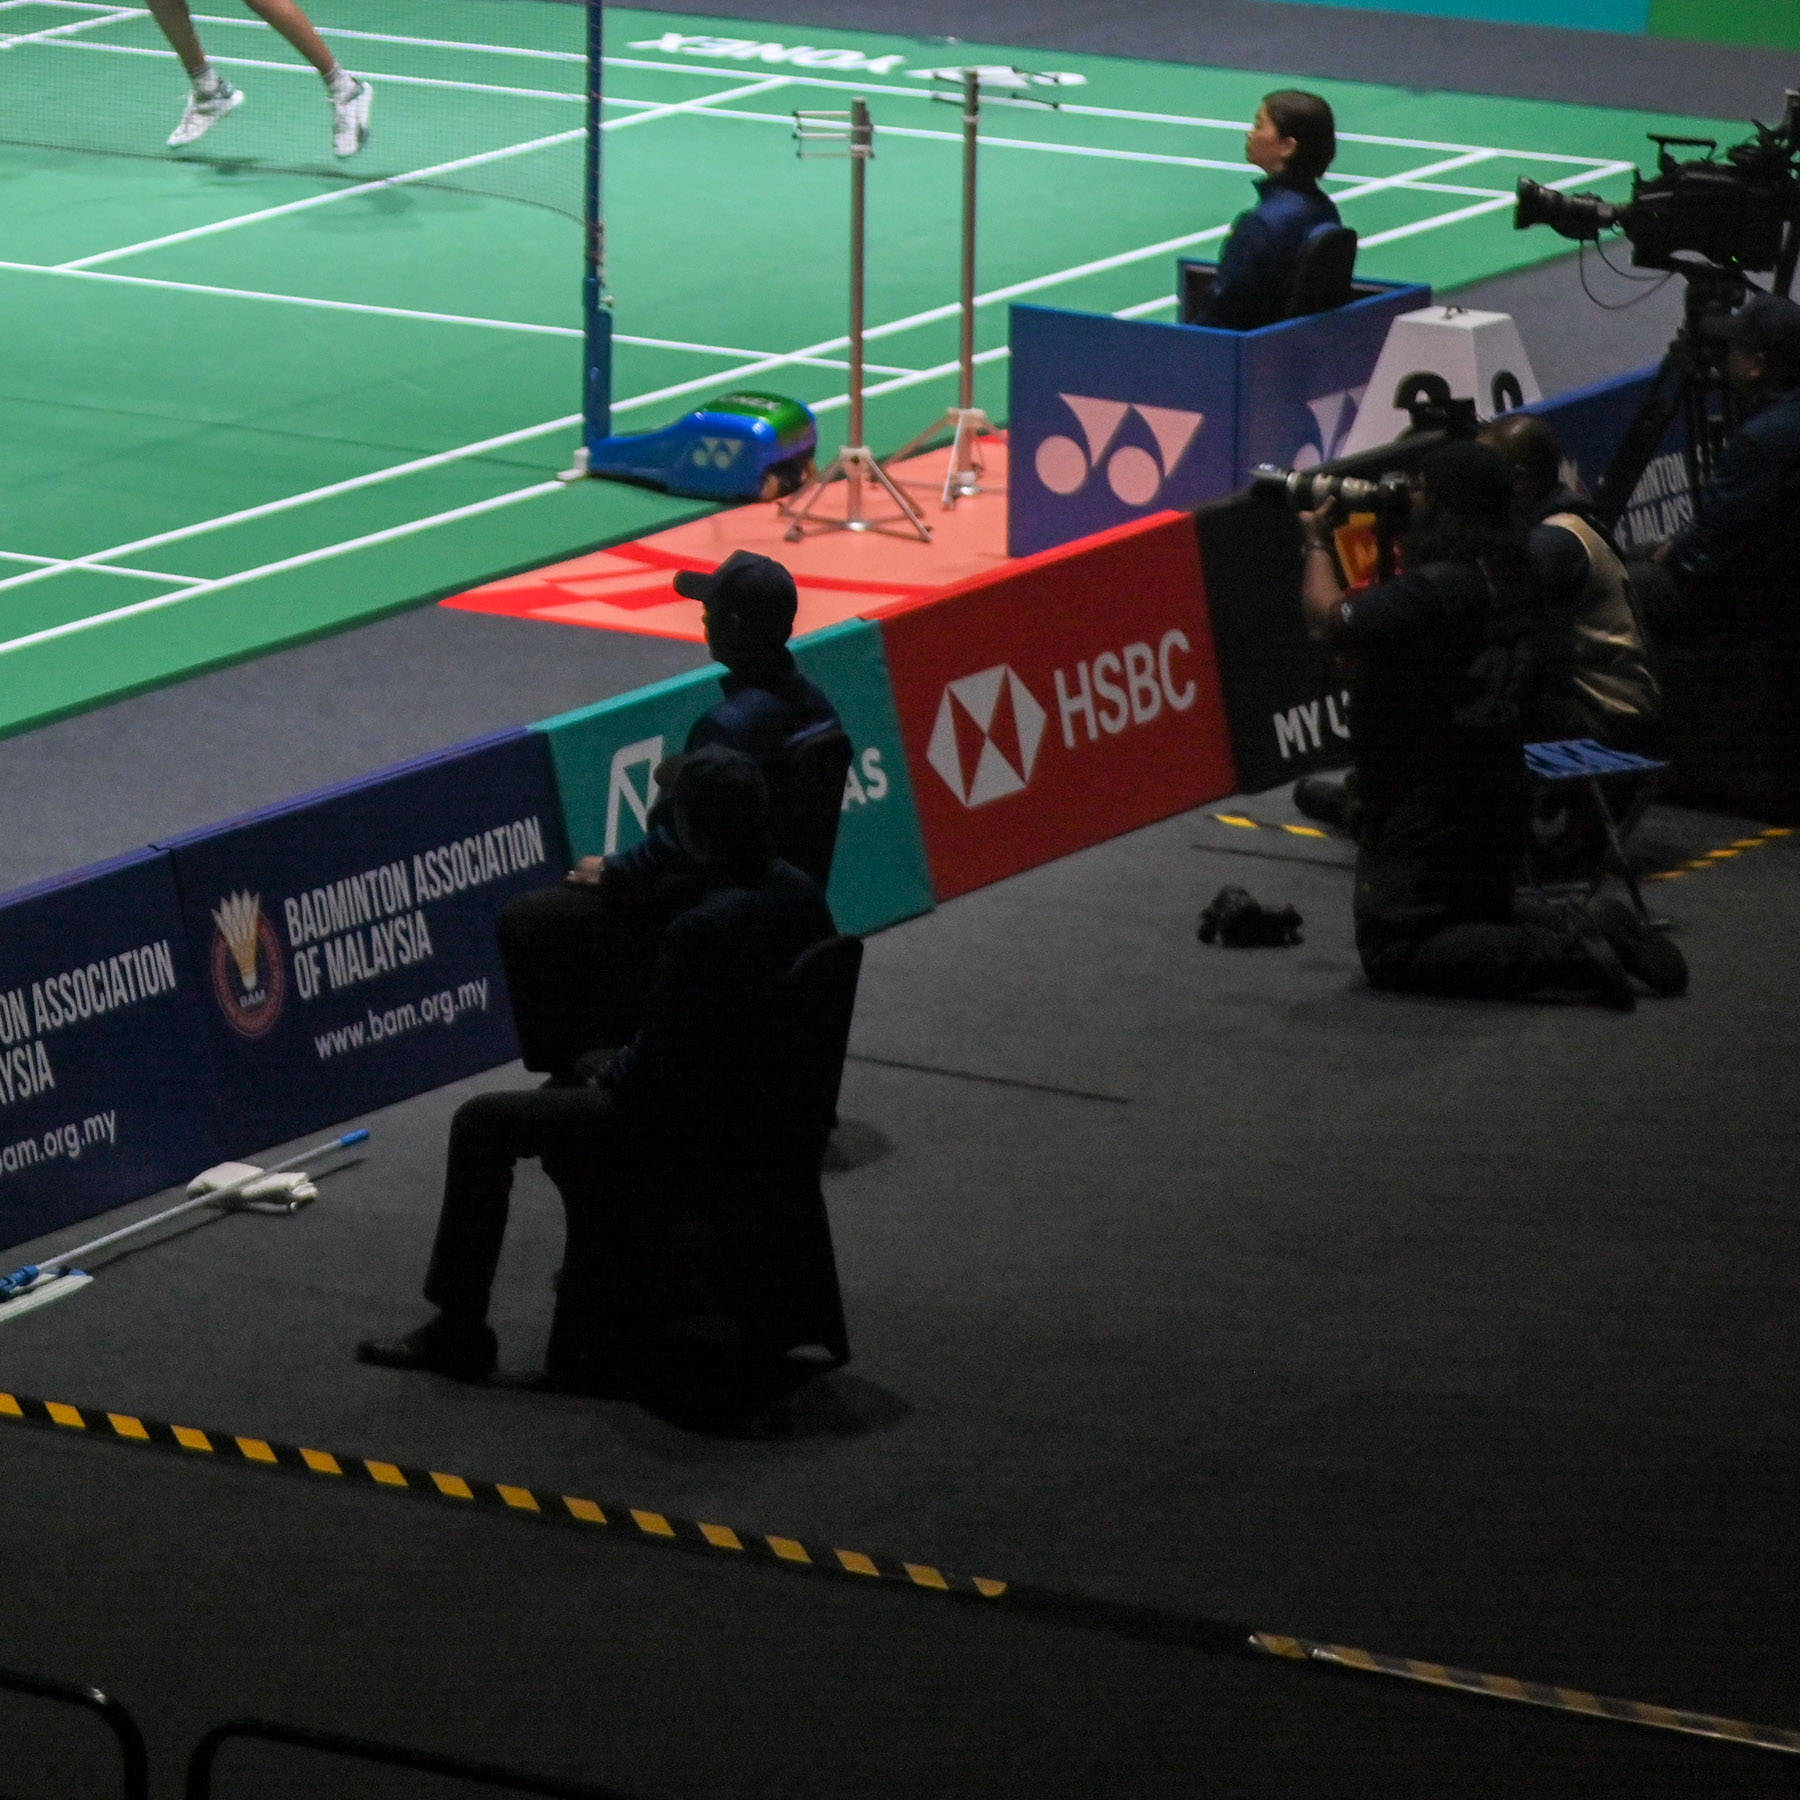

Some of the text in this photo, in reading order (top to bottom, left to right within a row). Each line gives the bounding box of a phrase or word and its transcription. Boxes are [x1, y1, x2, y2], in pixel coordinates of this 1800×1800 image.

[627, 32, 908, 75] YONEX
[1053, 628, 1198, 751] HSBC
[1273, 698, 1322, 760] MY
[284, 814, 546, 947] BADMINTON ASSOCIATION
[30, 938, 177, 1035] ASSOCIATION
[292, 950, 324, 1001] OF
[326, 908, 434, 990] MALAYSIA
[314, 976, 490, 1061] www.bam.org.my
